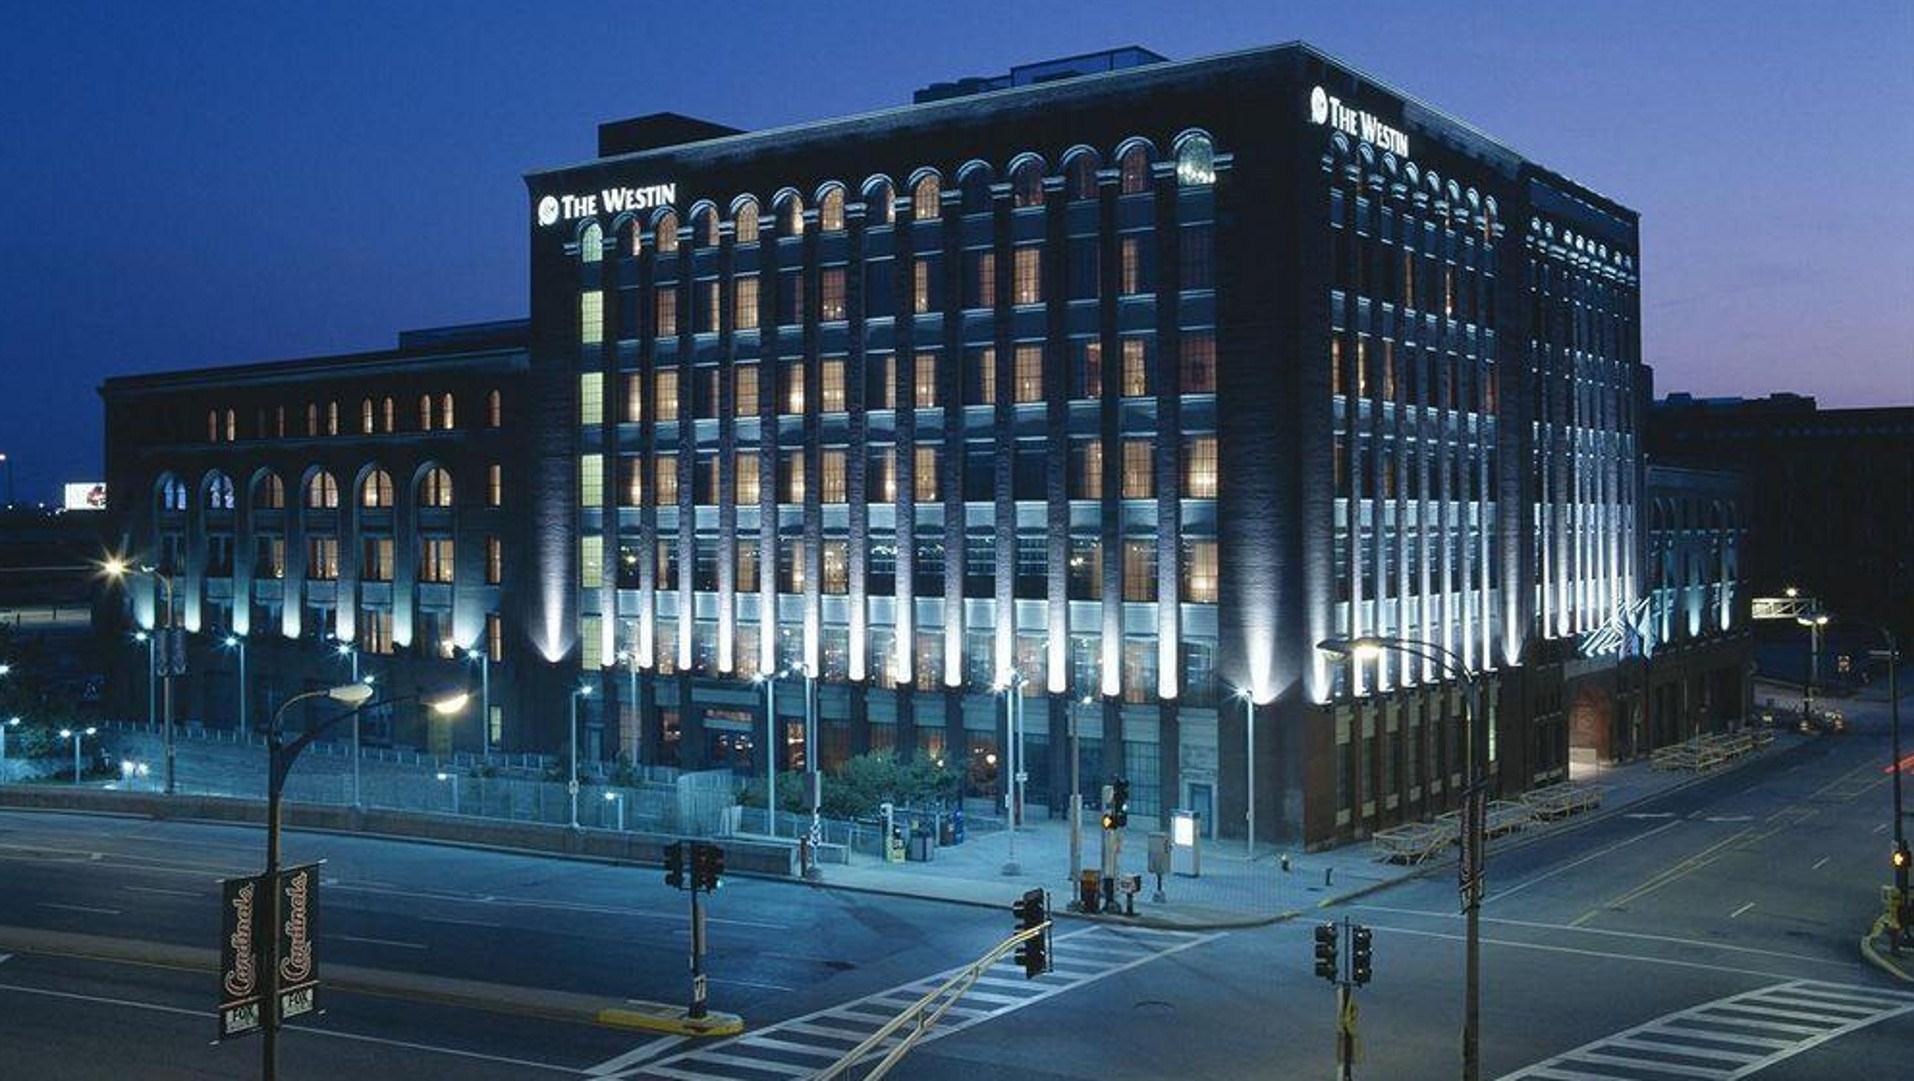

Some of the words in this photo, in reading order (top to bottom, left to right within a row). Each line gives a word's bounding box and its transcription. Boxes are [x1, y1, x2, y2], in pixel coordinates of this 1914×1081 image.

[1329, 96, 1357, 136] THE
[1359, 110, 1409, 158] WESTIN
[562, 195, 597, 219] THE
[602, 183, 676, 213] WESTIN
[225, 882, 256, 996] Cardinals
[281, 871, 311, 982] Cardinals
